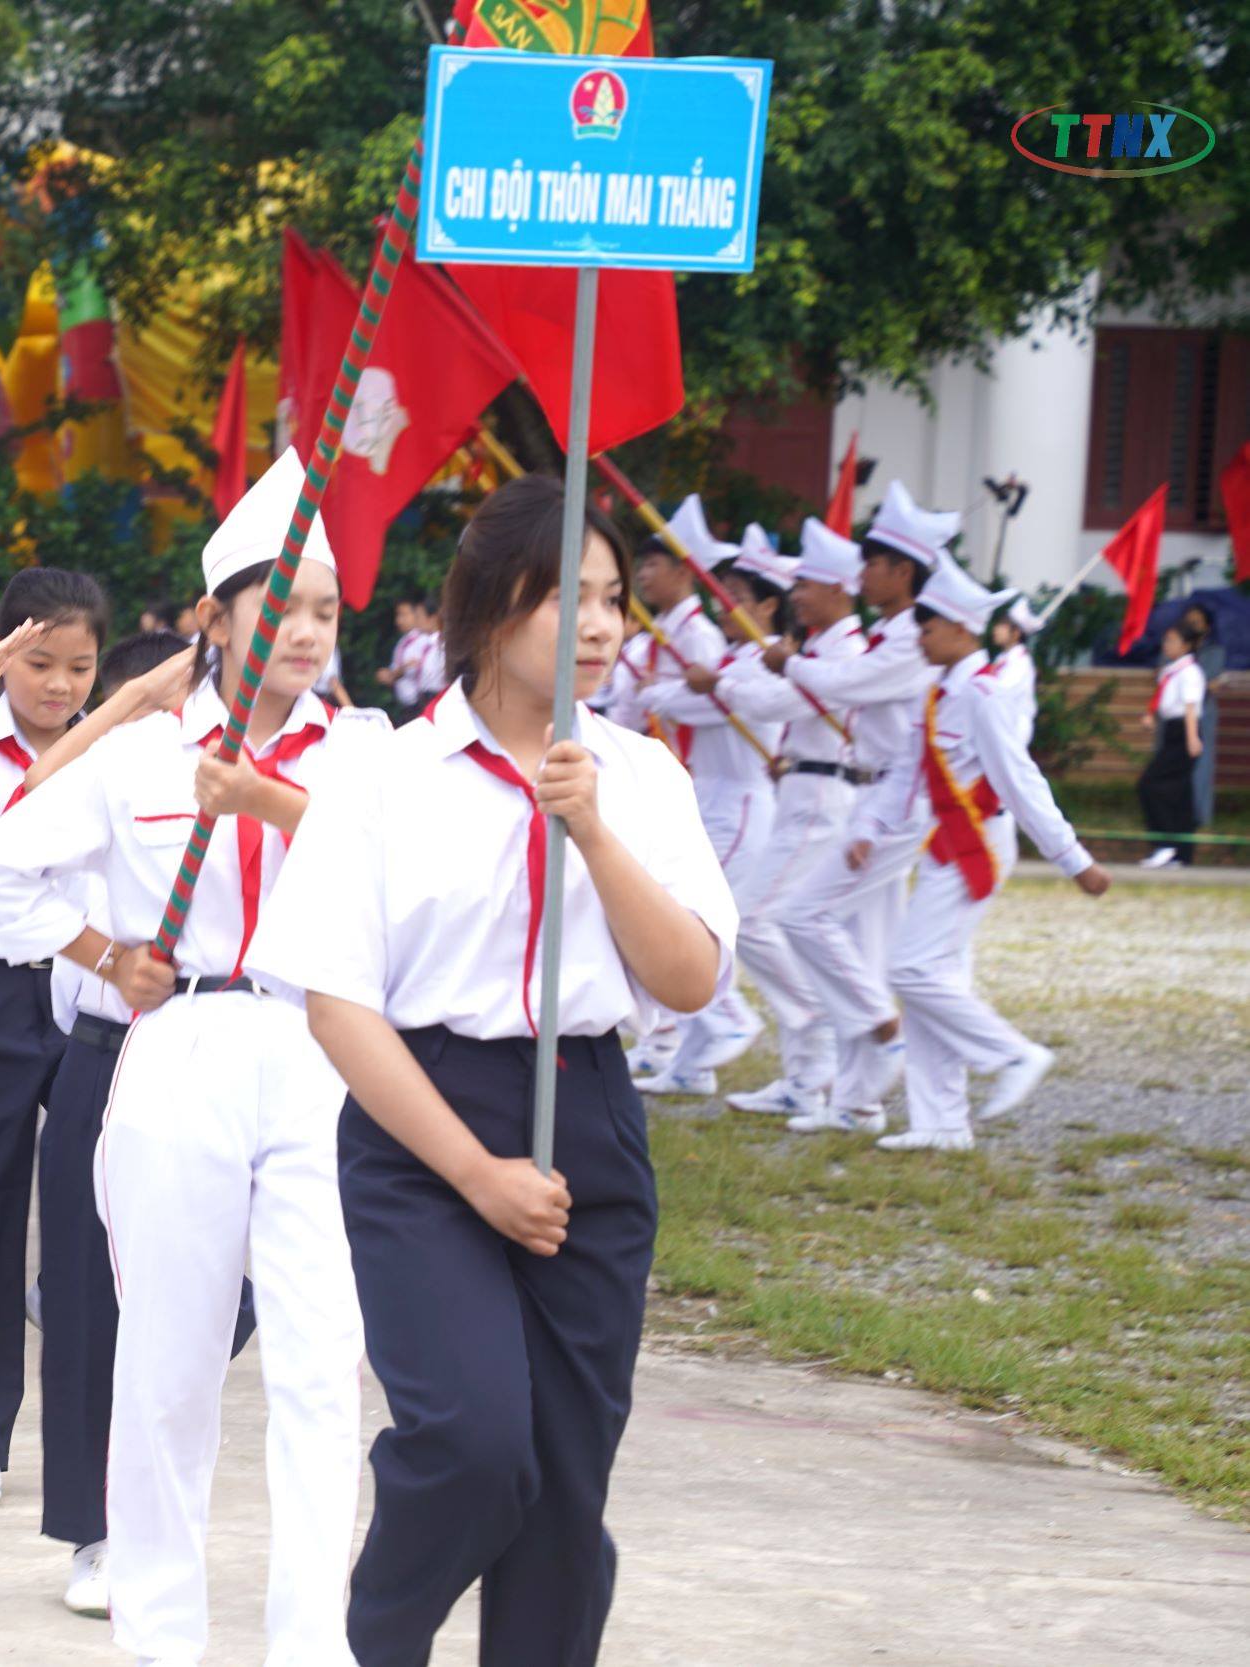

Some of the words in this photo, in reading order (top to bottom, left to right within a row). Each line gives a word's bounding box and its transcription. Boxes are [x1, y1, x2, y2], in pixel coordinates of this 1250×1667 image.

[445, 166, 486, 219] CHI
[490, 158, 532, 232] ĐỘI
[538, 161, 600, 224] THÔN
[604, 172, 653, 226] MAI
[658, 156, 736, 229] THẮNG
